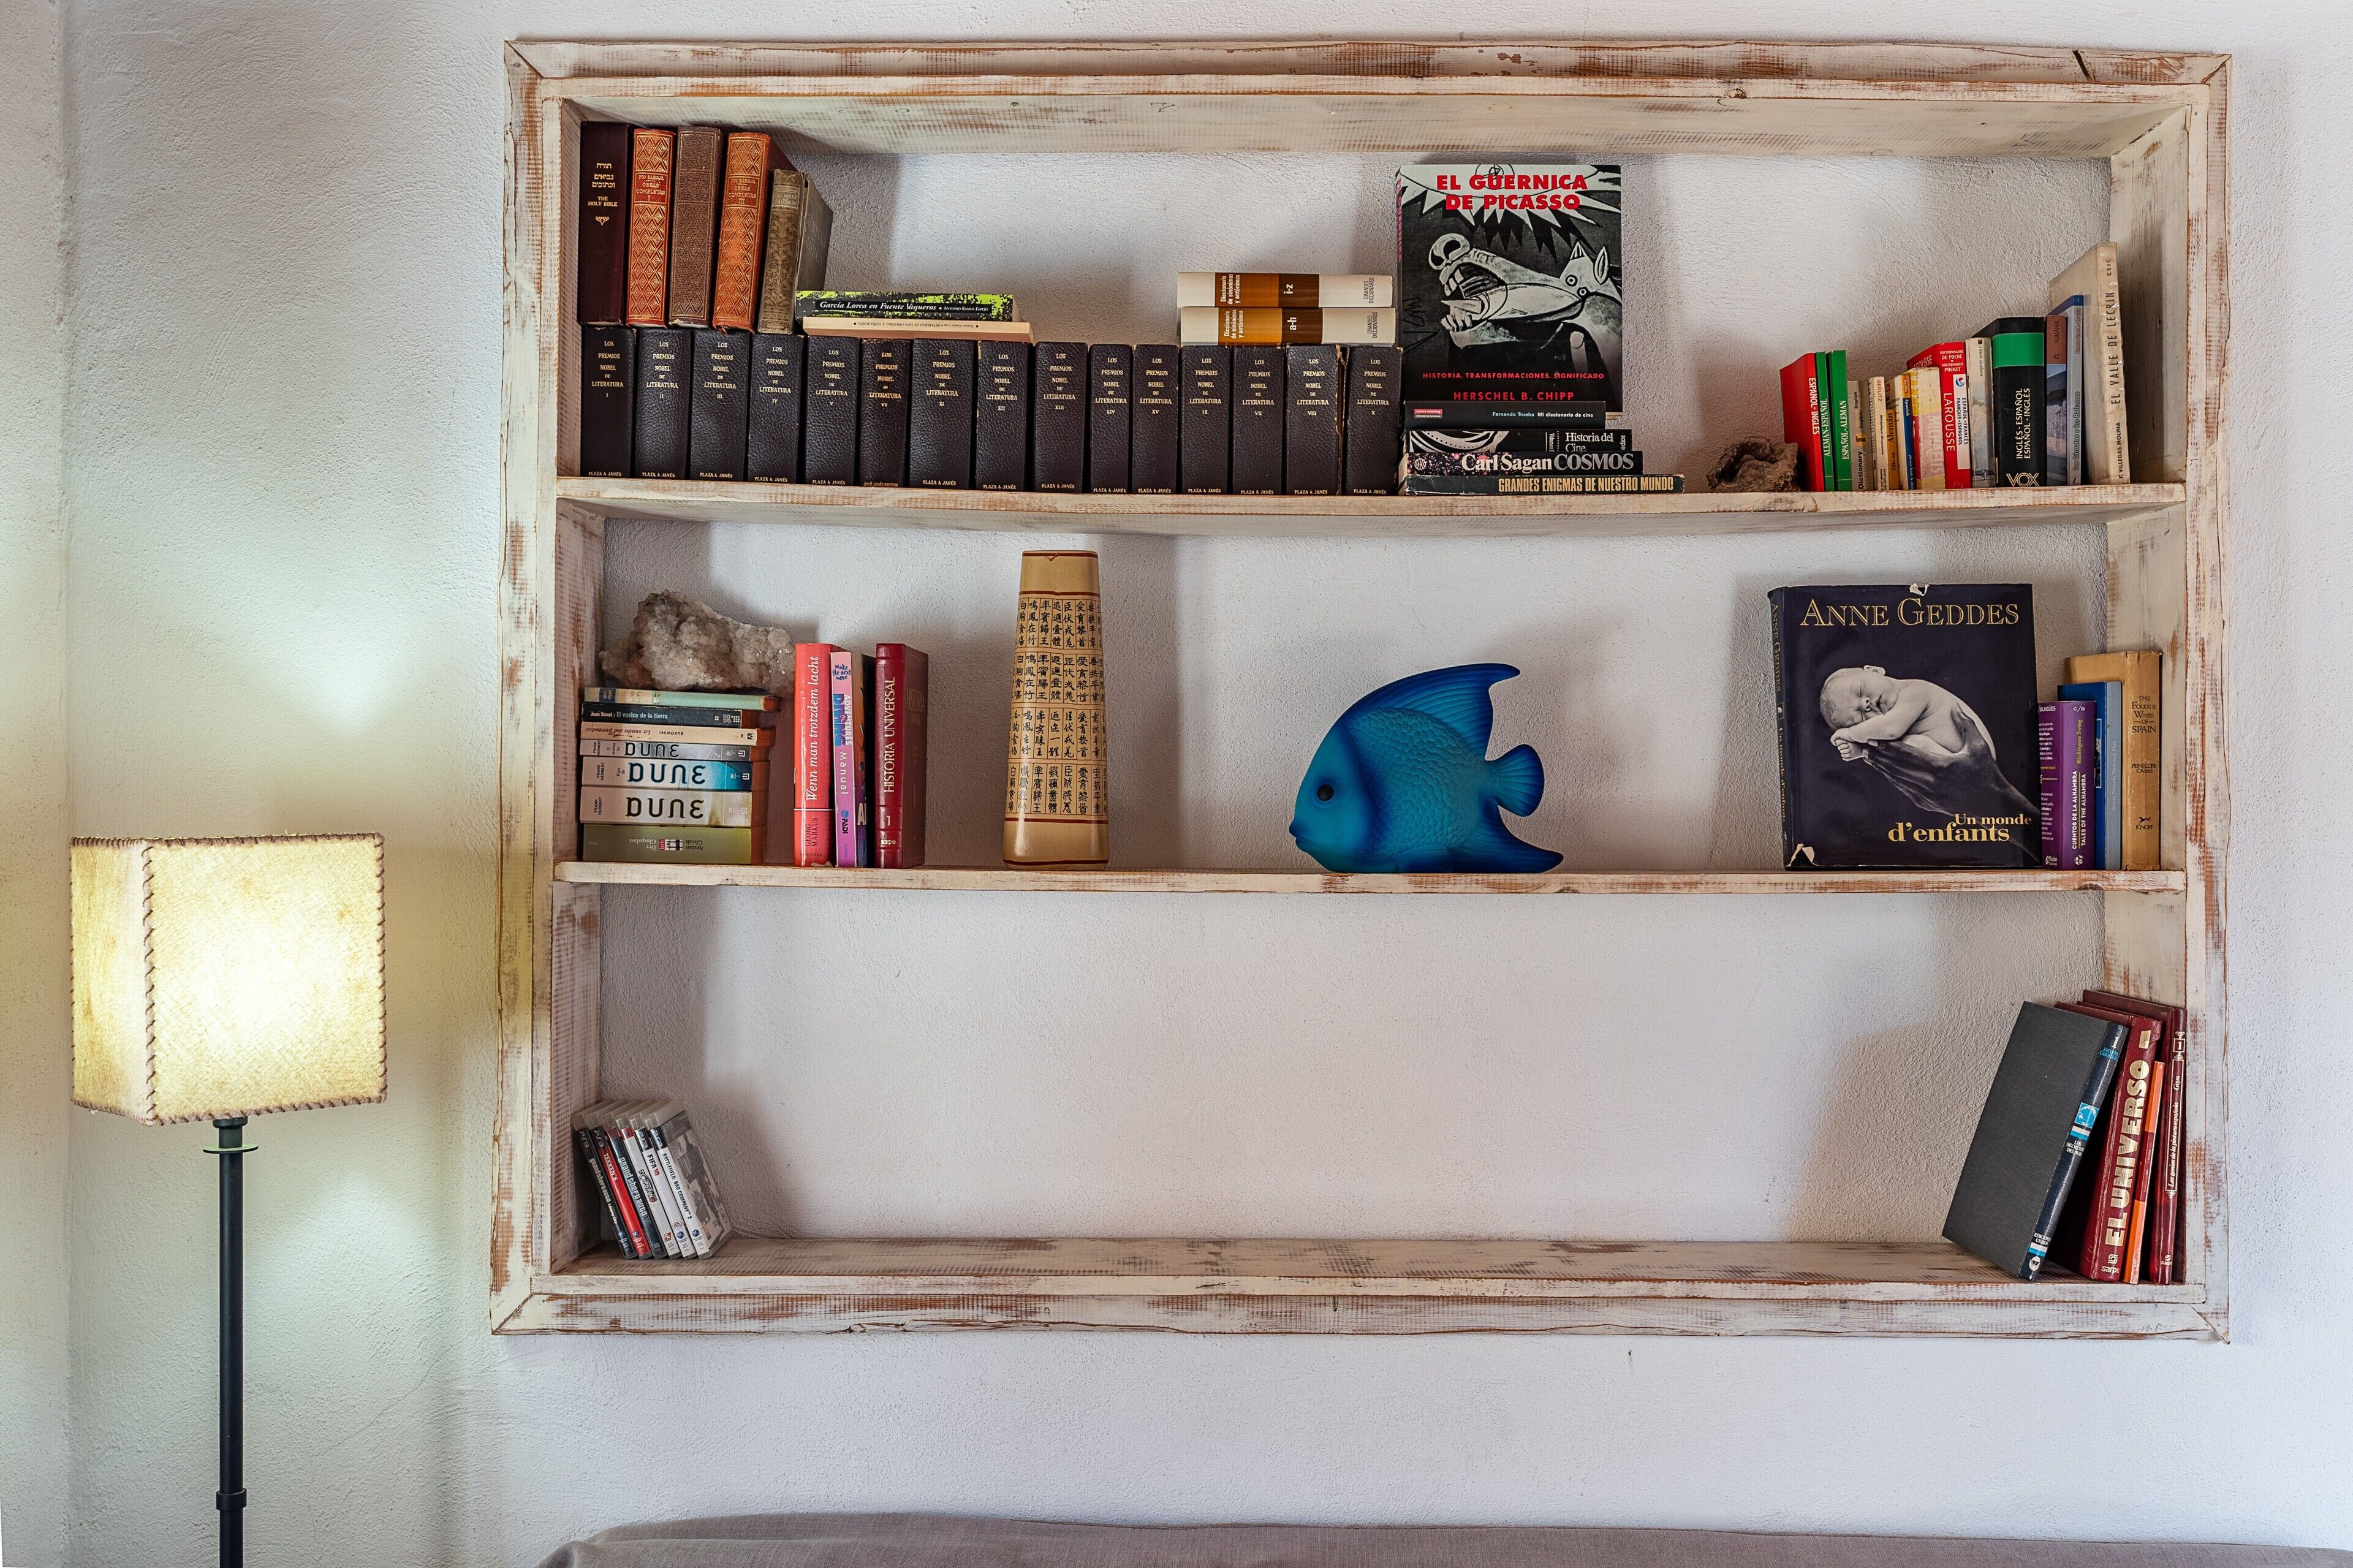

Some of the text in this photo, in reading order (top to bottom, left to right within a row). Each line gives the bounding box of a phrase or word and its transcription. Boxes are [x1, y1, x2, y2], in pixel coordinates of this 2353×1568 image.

[1436, 175, 1588, 190] EL GUERNICA
[1446, 194, 1580, 210] DE PICASSO
[1284, 284, 1293, 294] i-z
[906, 303, 936, 311] Vaqueros
[1287, 317, 1297, 331] a-h
[2105, 292, 2120, 404] EL VALLE DE LECRIN
[1537, 392, 1574, 401] CHIPP
[1944, 393, 1955, 451] LAROUSSE
[1566, 433, 1613, 442] Historia del
[1566, 443, 1586, 452] Cine
[1462, 453, 1634, 474] Carl Sagan COSMOS
[1498, 477, 1673, 492] GRANDES ENIGMAS DE NUESTRO MUNDO
[2006, 472, 2039, 487] VOX
[1799, 598, 2018, 626] ANNE GEDDES
[807, 656, 819, 686] lacht
[807, 690, 819, 738] trotzdem
[884, 677, 895, 792] HISTORIA UNIVERSAL
[840, 752, 849, 794] Manual
[806, 770, 817, 800] Wenn
[1955, 814, 2032, 825] Un monde
[2072, 811, 2077, 820] DE
[2081, 818, 2086, 827] OF
[1888, 822, 2009, 842] d'enfants
[2110, 1037, 2119, 1048] 1
[2105, 1060, 2150, 1246] EL UNIVERSO
[647, 1154, 657, 1168] FIFA
[662, 1153, 676, 1181] BATTLEFIELD:
[2101, 1265, 2120, 1274] sarpe
